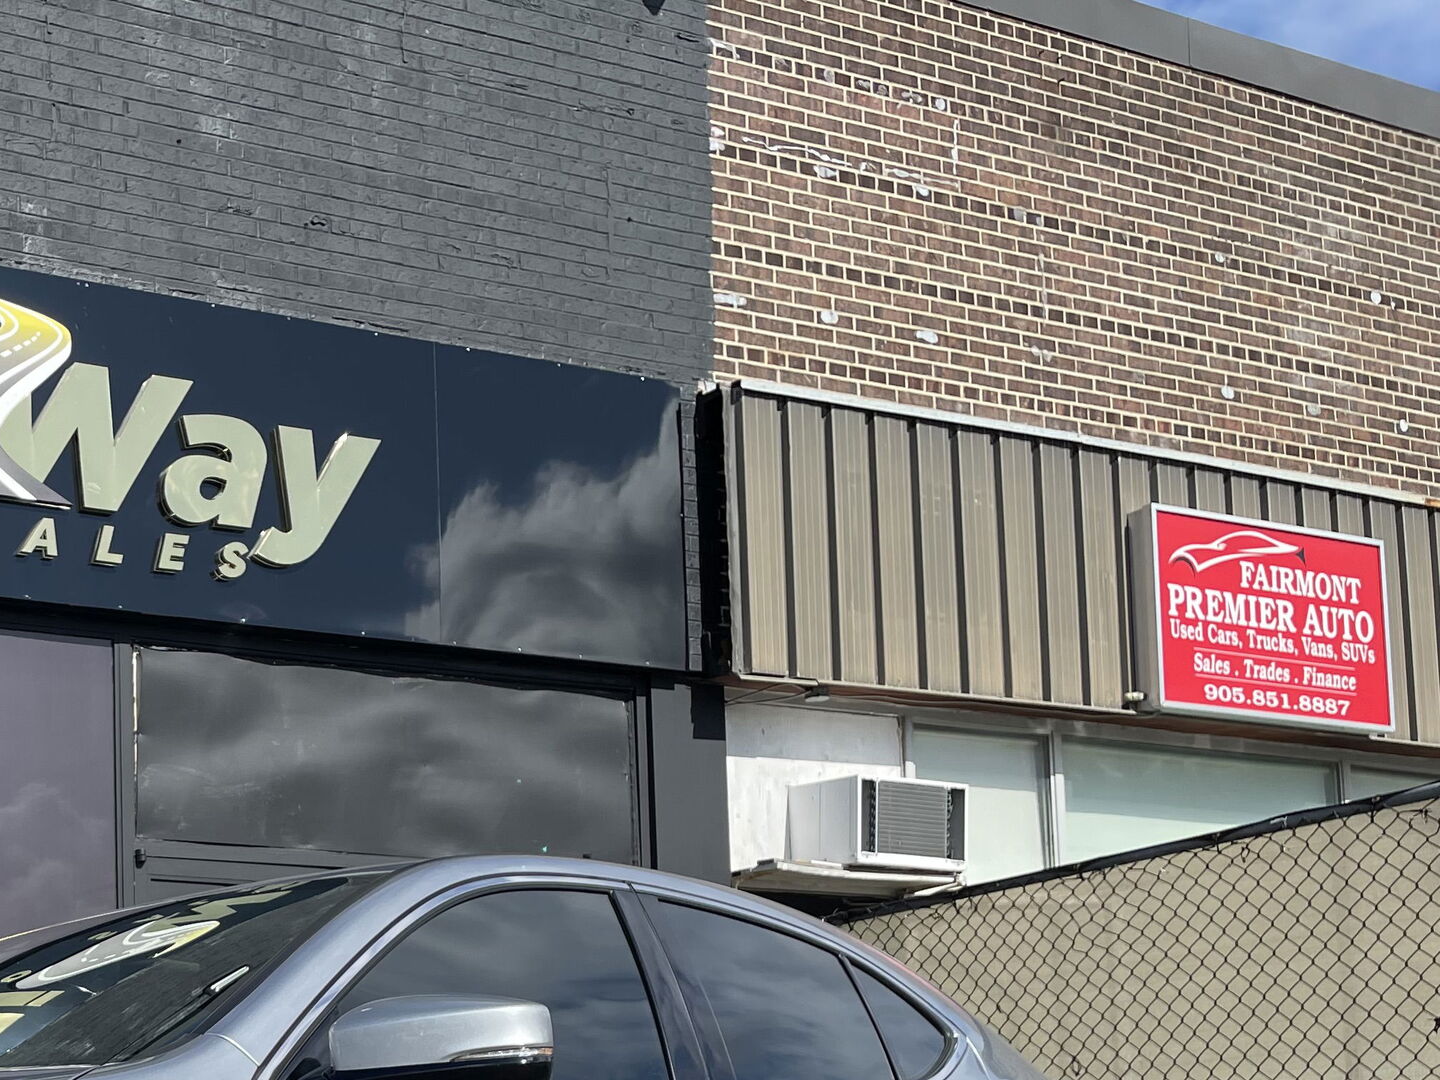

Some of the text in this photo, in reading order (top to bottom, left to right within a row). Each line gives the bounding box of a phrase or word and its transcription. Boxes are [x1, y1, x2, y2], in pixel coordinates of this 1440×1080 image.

[1239, 560, 1362, 605] FAIRMONT
[1167, 583, 1375, 644] PREMIER AUTO
[1169, 617, 1376, 664] Used Cars, Trucks, Vans, SUVs
[1193, 652, 1231, 676] Sales
[1243, 659, 1290, 683] Trades
[1302, 666, 1357, 691] Finance
[1203, 683, 1351, 716] 905.851.8887
